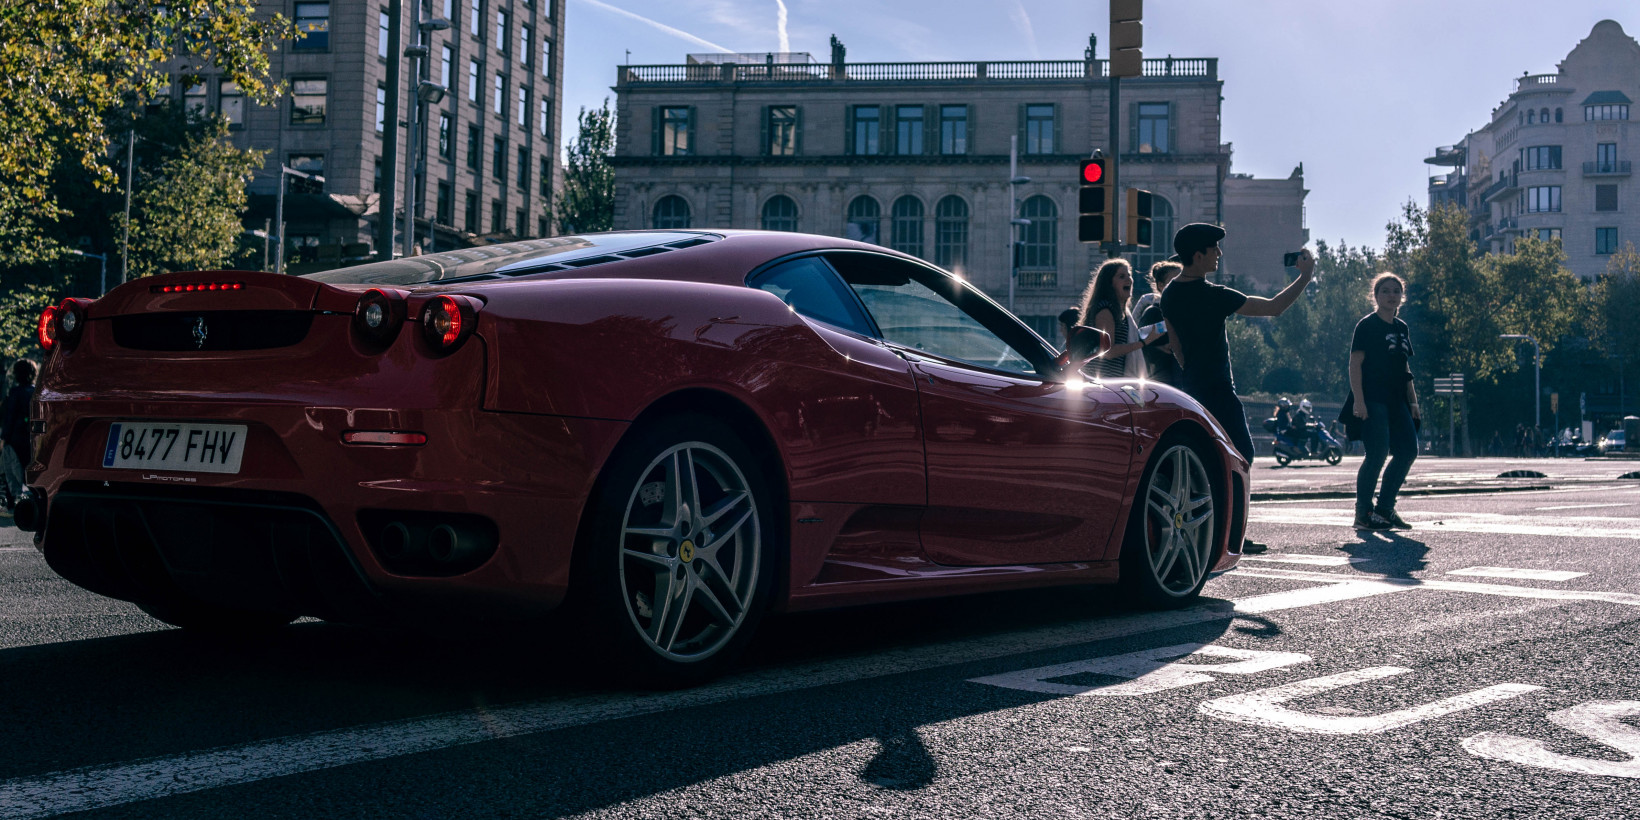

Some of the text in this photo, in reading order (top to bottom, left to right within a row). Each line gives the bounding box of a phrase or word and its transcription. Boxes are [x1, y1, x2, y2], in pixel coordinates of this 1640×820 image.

[121, 429, 236, 464] 8477 FHV
[966, 643, 1640, 777] BUS
